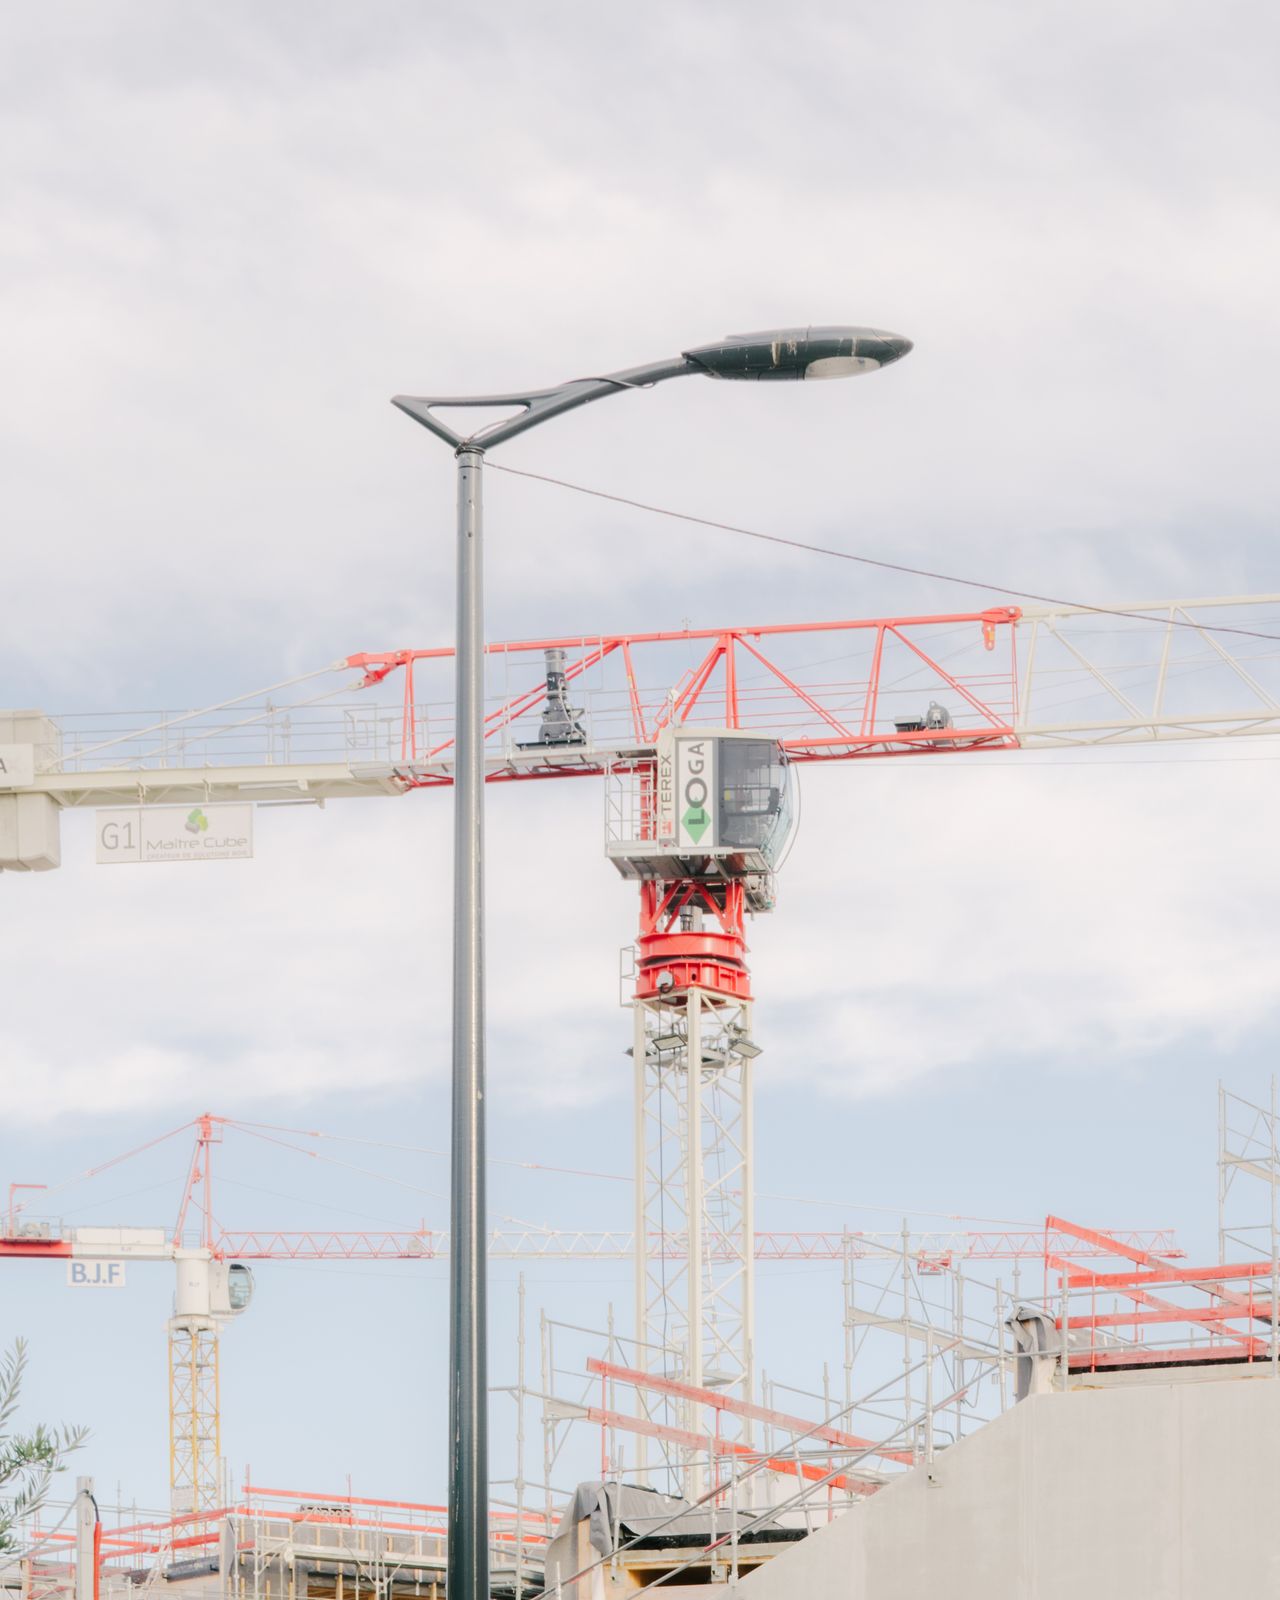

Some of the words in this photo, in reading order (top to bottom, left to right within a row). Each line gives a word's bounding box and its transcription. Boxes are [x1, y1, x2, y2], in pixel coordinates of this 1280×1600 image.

[661, 754, 671, 813] TEREX
[685, 742, 708, 825] LOGA
[101, 822, 136, 850] G1
[203, 836, 248, 848] Cube
[72, 1263, 120, 1284] B.J.F
